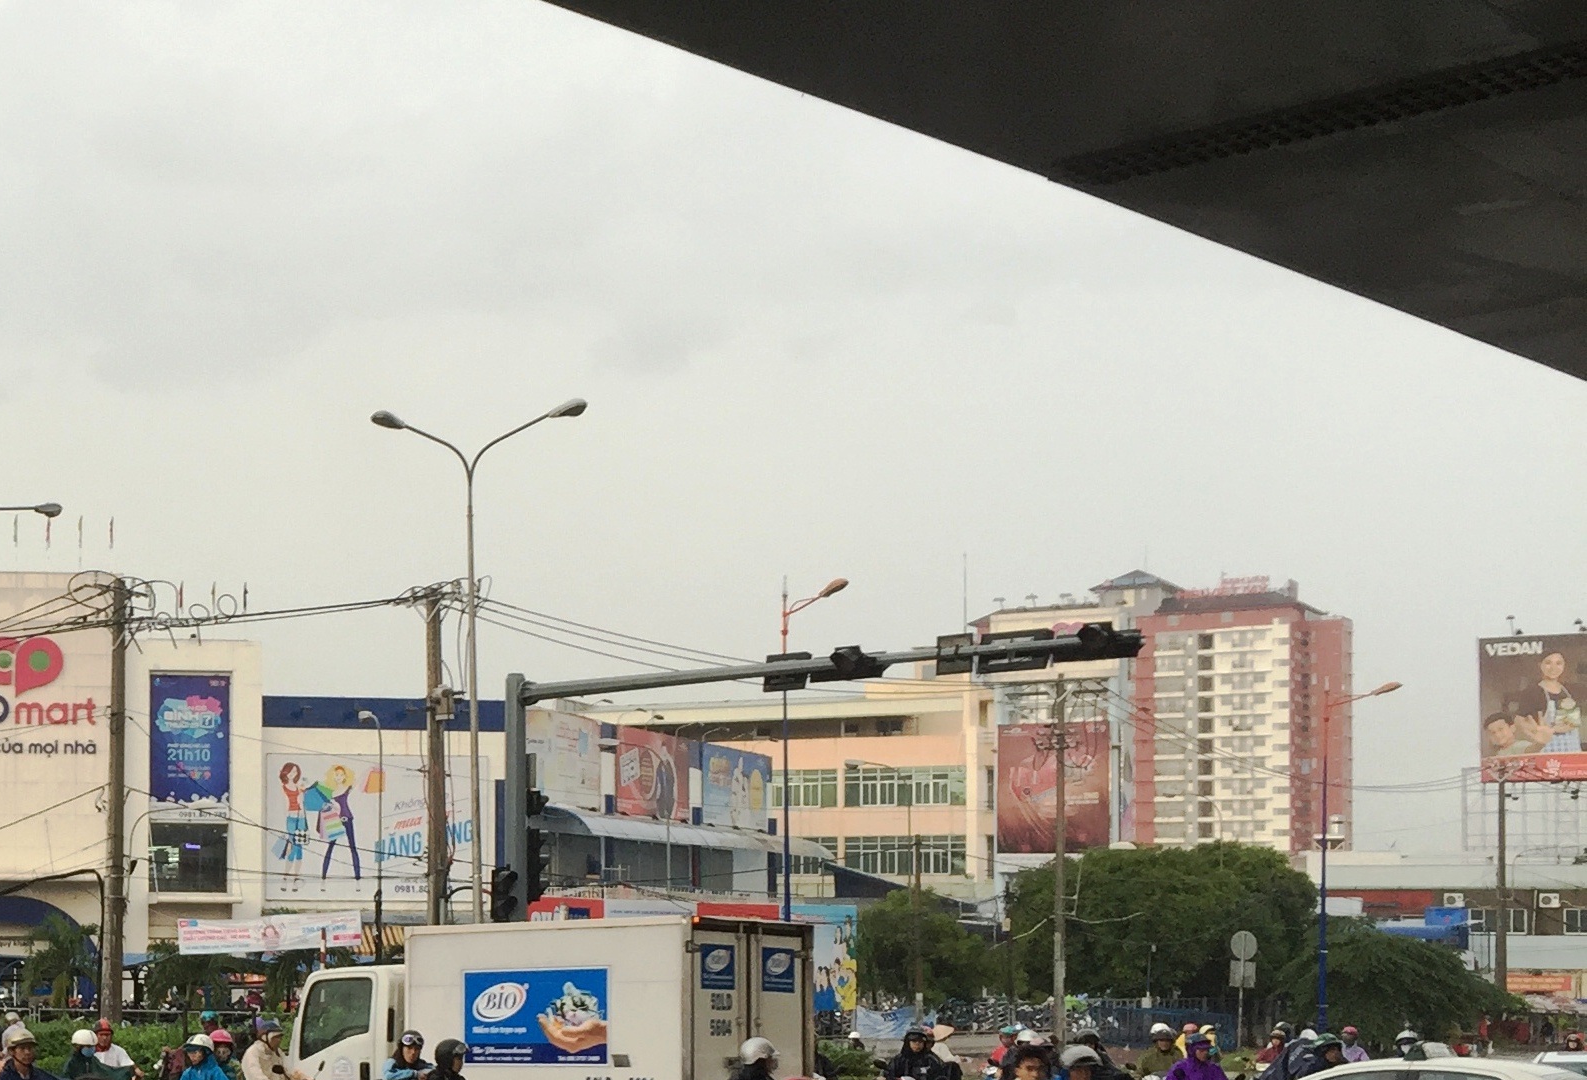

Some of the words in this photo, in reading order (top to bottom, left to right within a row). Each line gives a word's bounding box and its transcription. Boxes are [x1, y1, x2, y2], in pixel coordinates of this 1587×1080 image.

[1485, 641, 1544, 656] VEDAN
[28, 739, 59, 758] mọi
[64, 739, 97, 754] nhà
[167, 748, 211, 761] 21h10
[483, 987, 518, 1010] BIO
